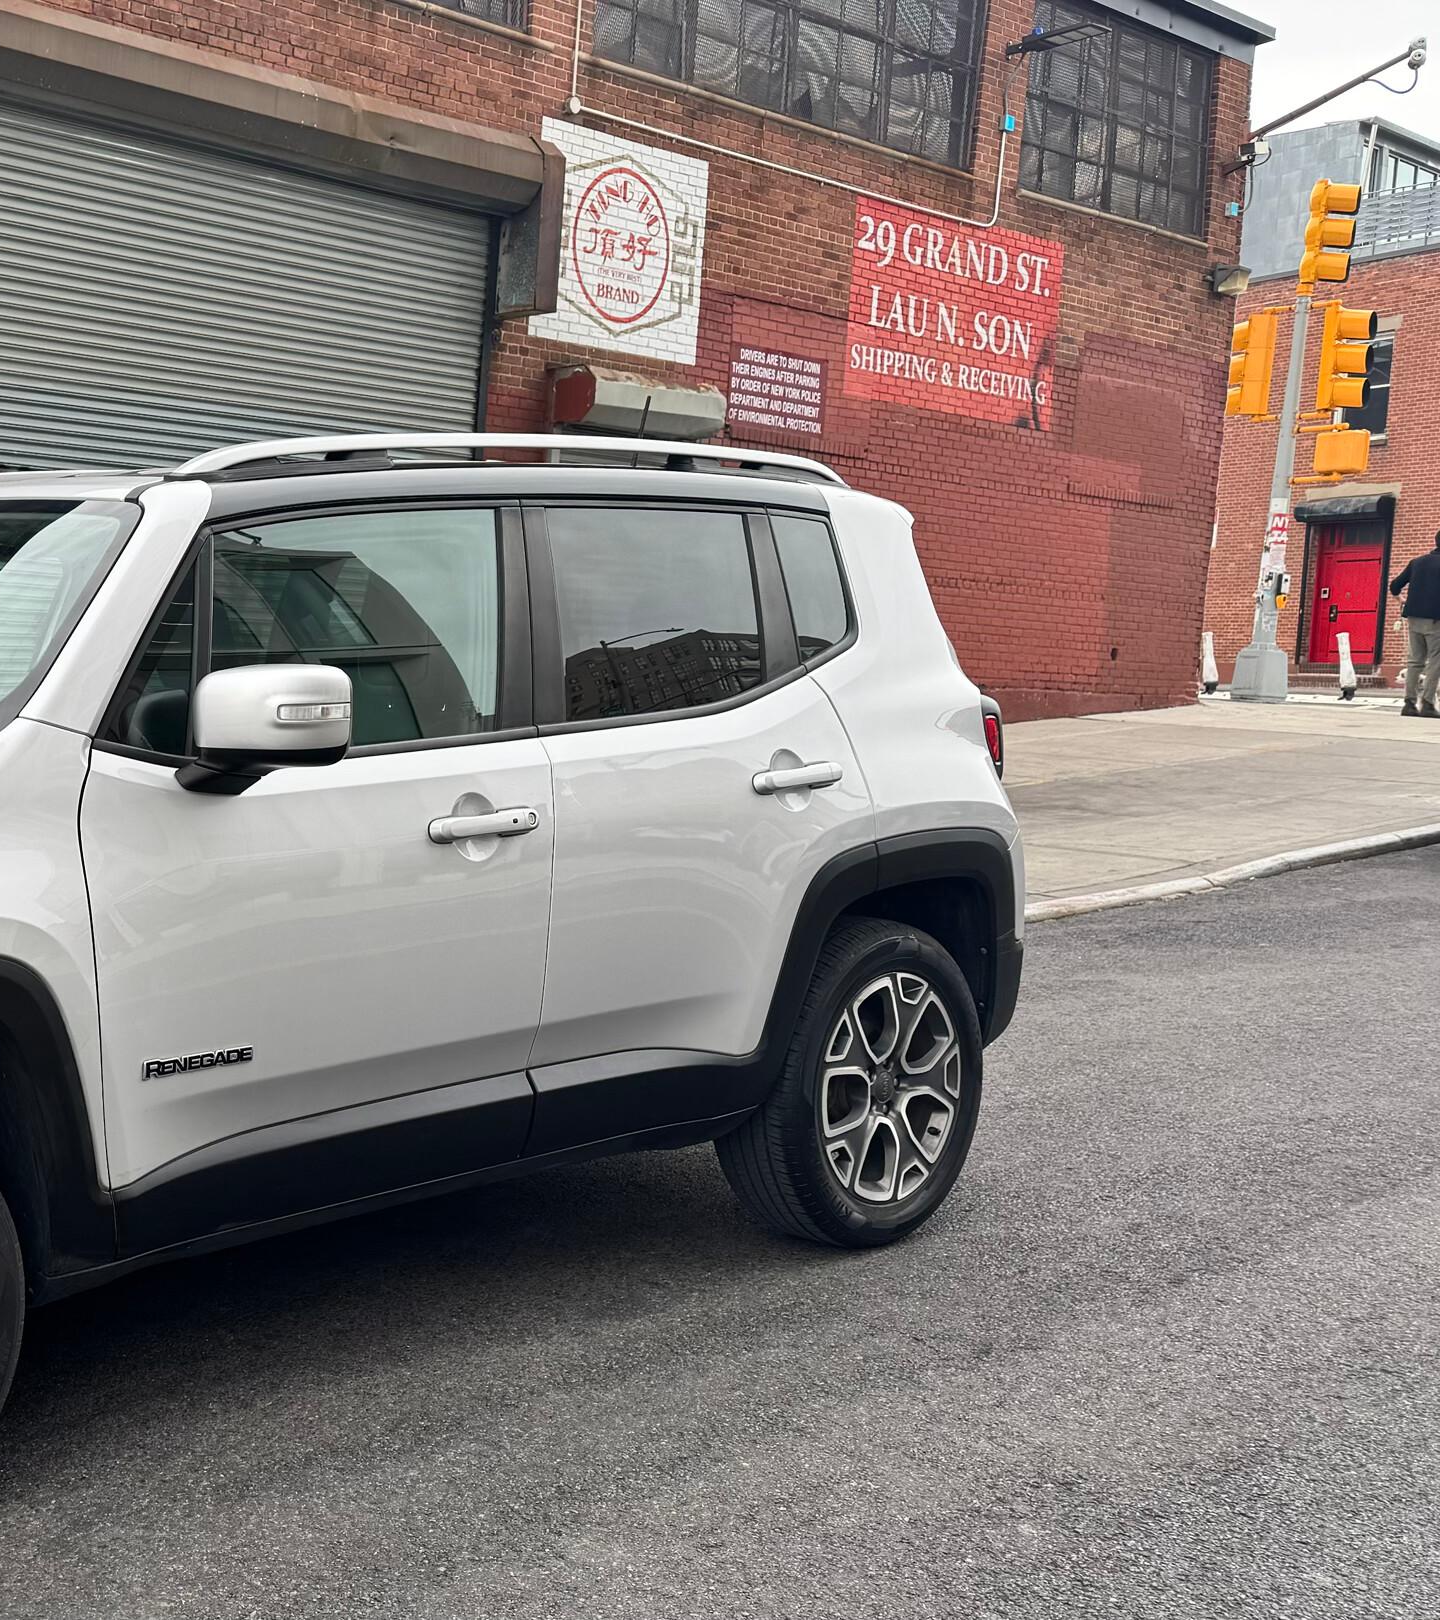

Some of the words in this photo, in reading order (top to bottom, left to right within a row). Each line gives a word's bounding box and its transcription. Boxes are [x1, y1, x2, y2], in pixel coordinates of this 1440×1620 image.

[583, 227, 658, 271] 頂好
[857, 215, 897, 267] 29
[902, 223, 1009, 286] GRAND
[1014, 251, 1050, 298] ST.
[597, 283, 640, 304] BRAND
[868, 284, 929, 338] LAU
[935, 301, 965, 347] N.
[972, 310, 1033, 360] SON
[732, 361, 750, 375] THEIR
[750, 365, 775, 380] ENGINES
[776, 370, 794, 384] AFTER
[795, 374, 820, 389] PARKING
[740, 348, 766, 364] DRIVERS
[766, 352, 778, 366] ARE
[779, 355, 787, 368] TO
[787, 357, 803, 371] SHUT
[803, 361, 821, 375] DOWN
[850, 343, 937, 384] SHIPPING
[940, 362, 953, 387] &
[958, 364, 1047, 405] RECEIVING
[731, 376, 740, 389] BY
[741, 379, 761, 393] ORDER
[762, 382, 771, 394] OF
[771, 385, 785, 397] NEW
[785, 387, 801, 401] YORK
[801, 390, 821, 404] POLICE
[730, 392, 770, 410] DEPARTMENT
[769, 399, 782, 412] AND
[782, 401, 820, 419] DEPARTMENT
[728, 408, 738, 419] OF
[738, 409, 785, 429] ENVIRONMENTAL
[785, 418, 822, 434] PROTECTION.
[141, 1045, 253, 1081] RENEGADE
